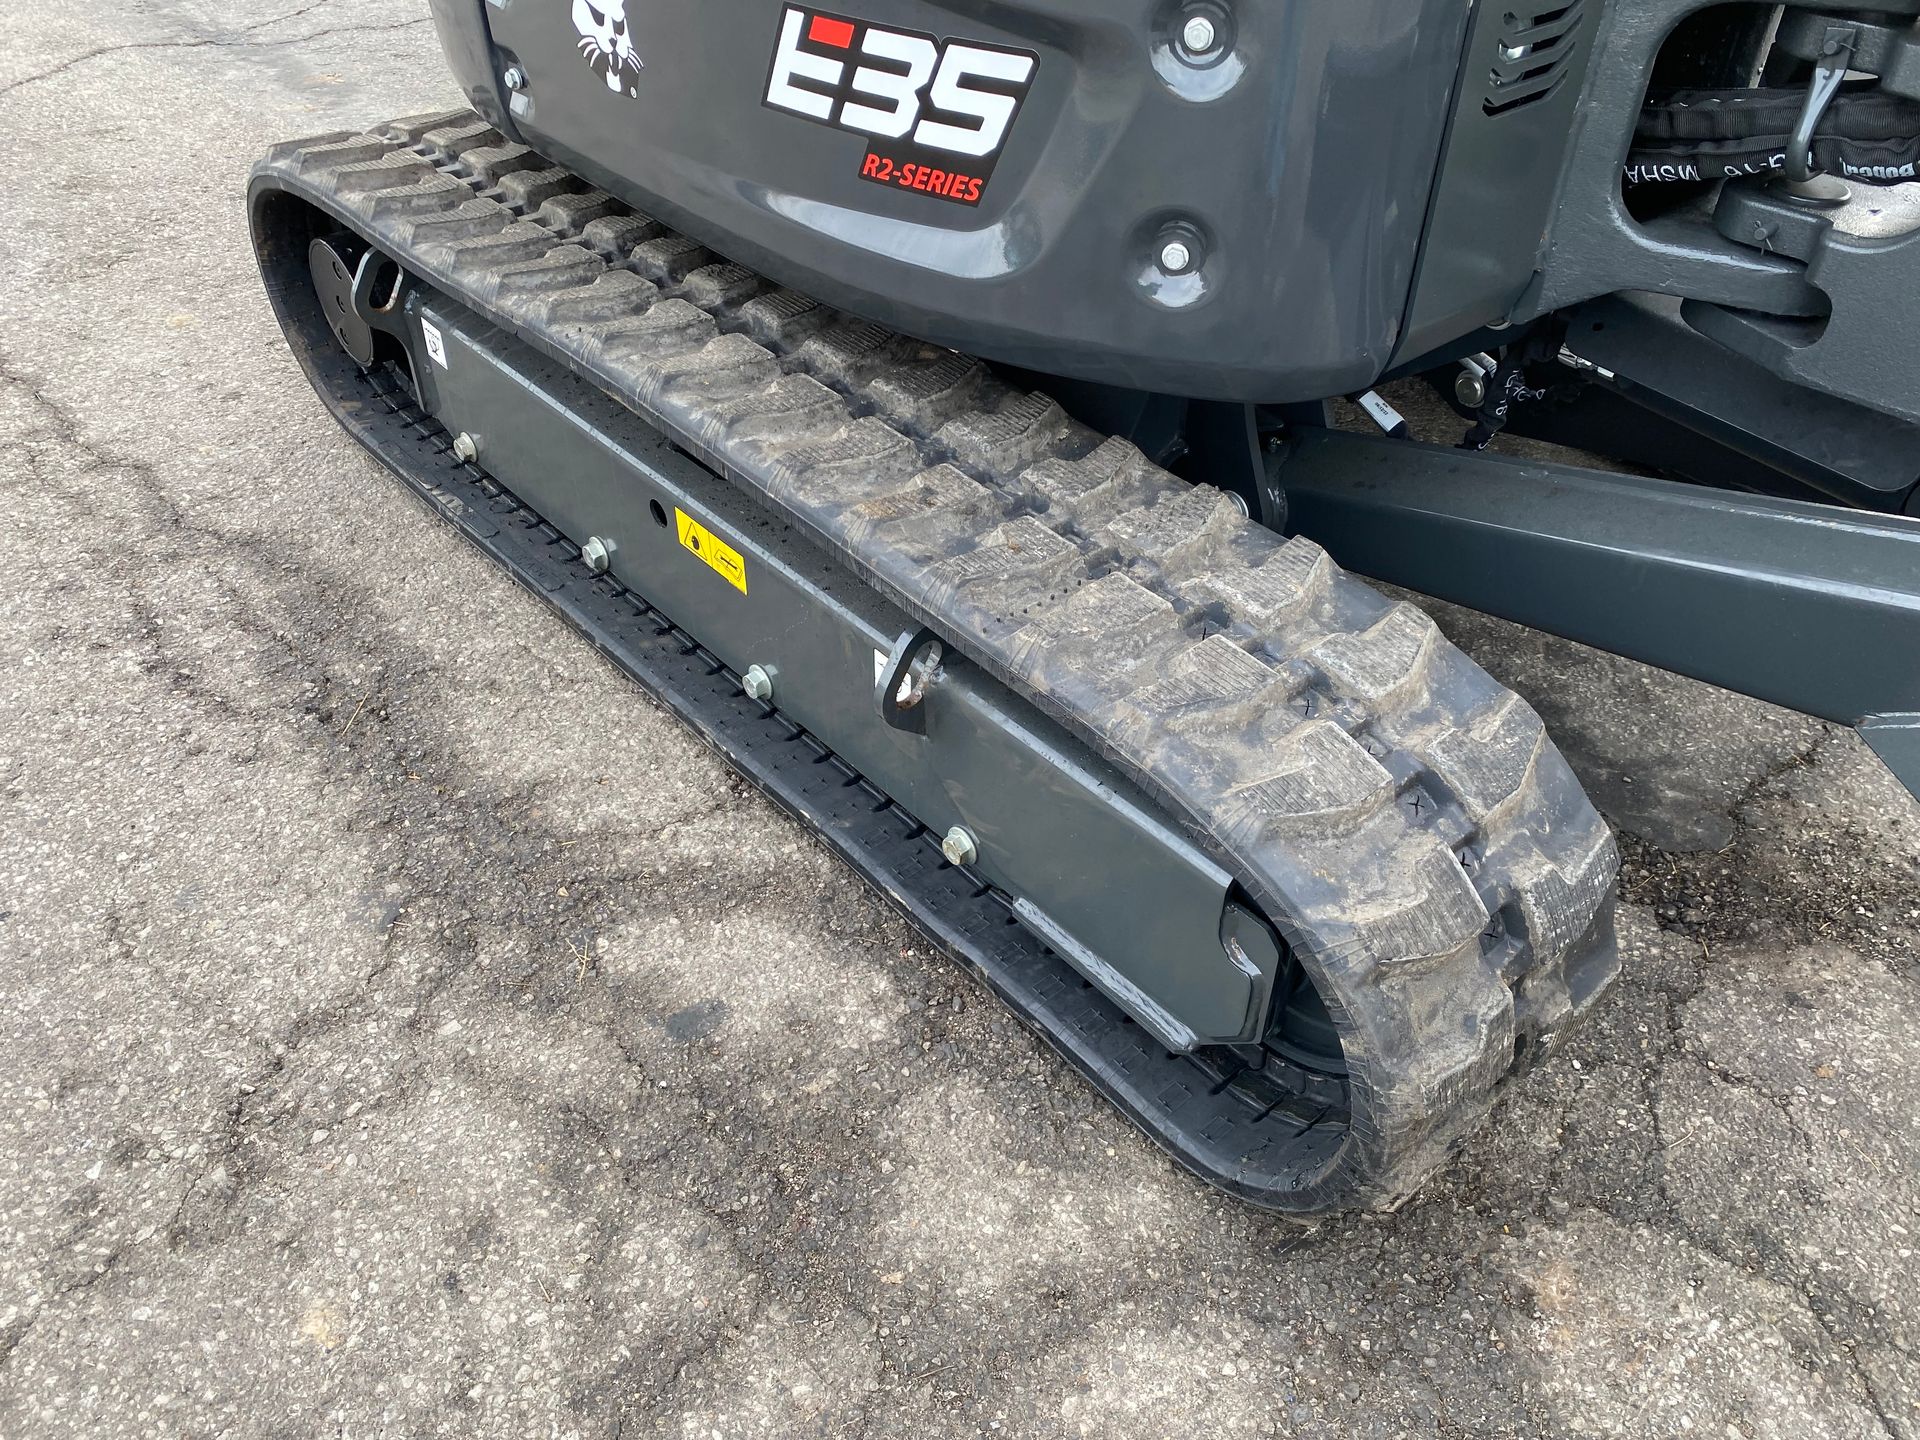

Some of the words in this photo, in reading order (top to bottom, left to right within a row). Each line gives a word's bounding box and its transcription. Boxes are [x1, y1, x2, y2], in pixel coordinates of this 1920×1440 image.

[766, 8, 1034, 156] E35
[862, 153, 983, 201] R2-SERIES
[1624, 163, 1702, 184] MSHA
